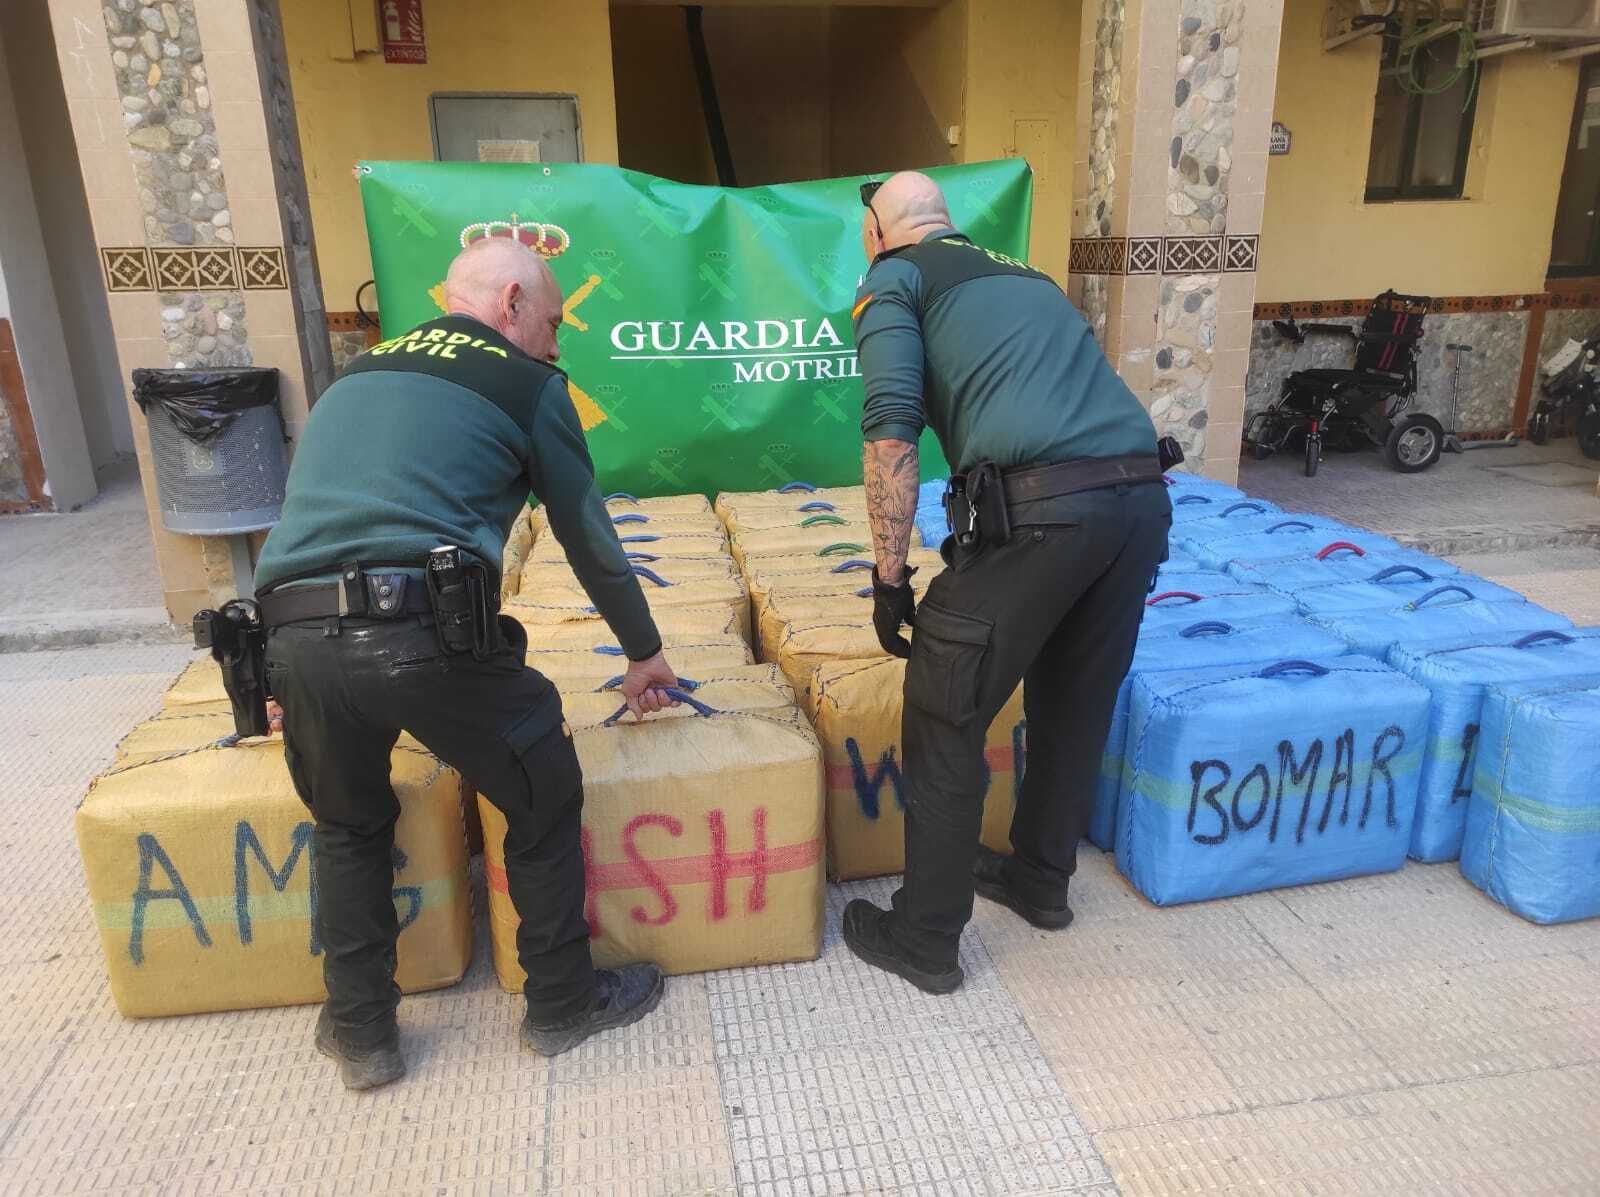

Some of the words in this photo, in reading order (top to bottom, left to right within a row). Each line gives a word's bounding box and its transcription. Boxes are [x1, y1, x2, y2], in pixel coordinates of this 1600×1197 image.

[610, 317, 844, 351] GUARDIA
[371, 341, 457, 359] CIVIL
[733, 356, 862, 383] MOTRIL
[1186, 724, 1406, 846] BOMAR
